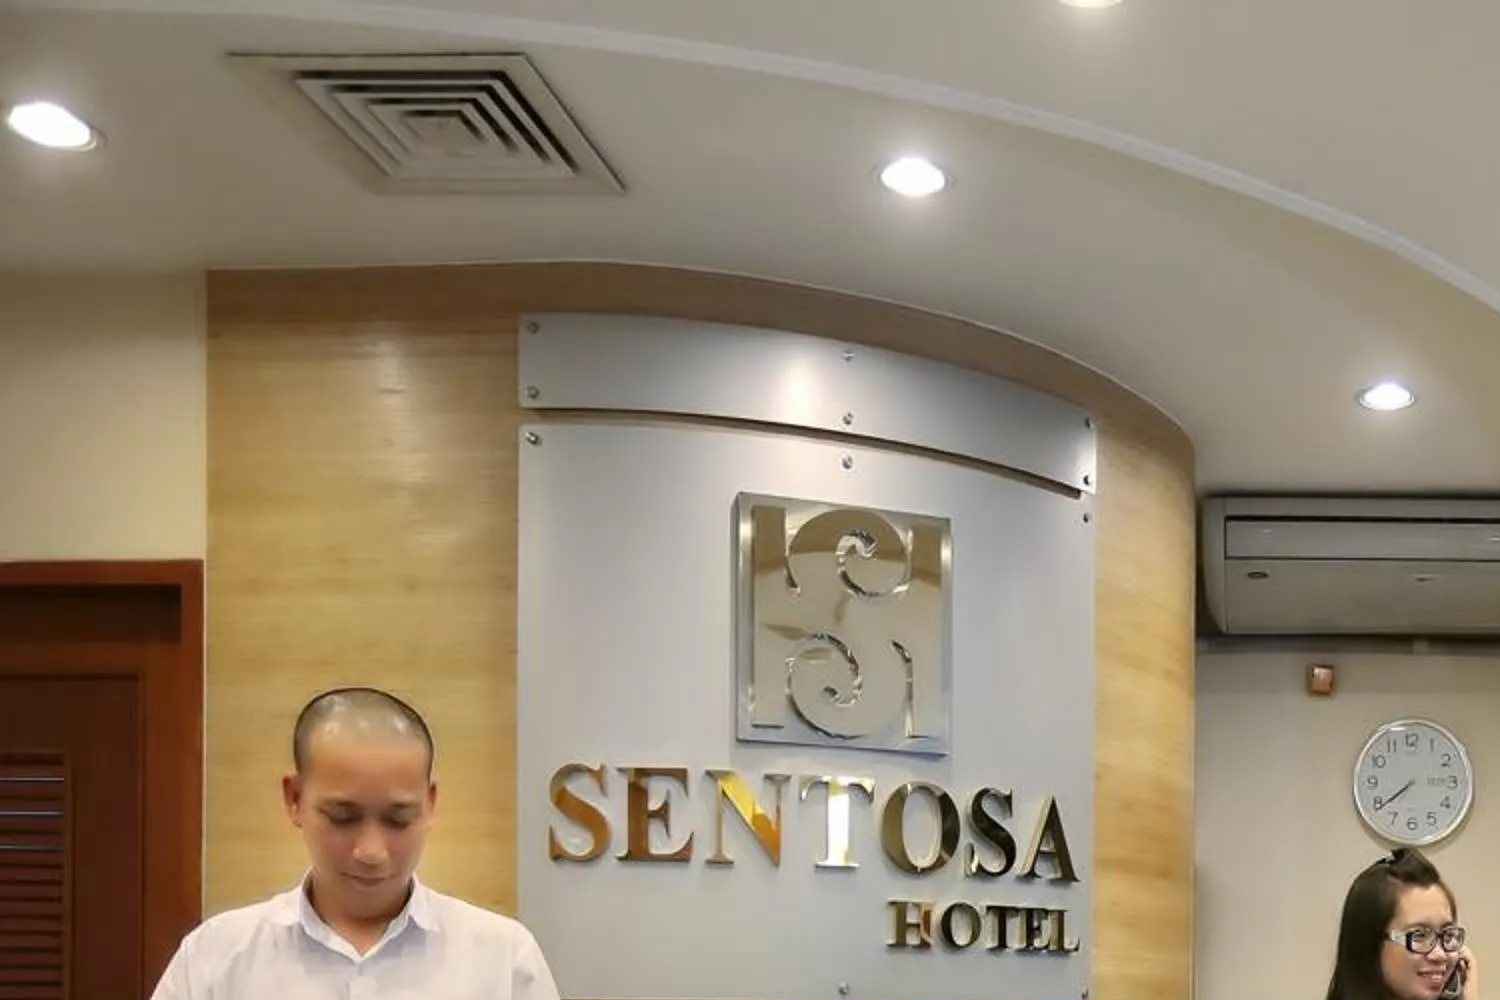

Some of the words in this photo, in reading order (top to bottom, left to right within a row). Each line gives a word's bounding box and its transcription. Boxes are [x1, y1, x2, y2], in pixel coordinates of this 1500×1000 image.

[1387, 739, 1397, 753] 11
[1405, 732, 1419, 748] 12
[1372, 754, 1386, 769] 10
[1441, 753, 1452, 767] 2
[1367, 775, 1378, 789] 9
[1447, 775, 1458, 790] 3
[1373, 796, 1384, 811] 8
[1440, 796, 1451, 809] 4
[548, 762, 1080, 884] SENTOSA
[1388, 811, 1399, 825] 7
[1406, 817, 1418, 831] 6
[1427, 811, 1437, 826] 5
[885, 900, 1080, 955] HOTEL
